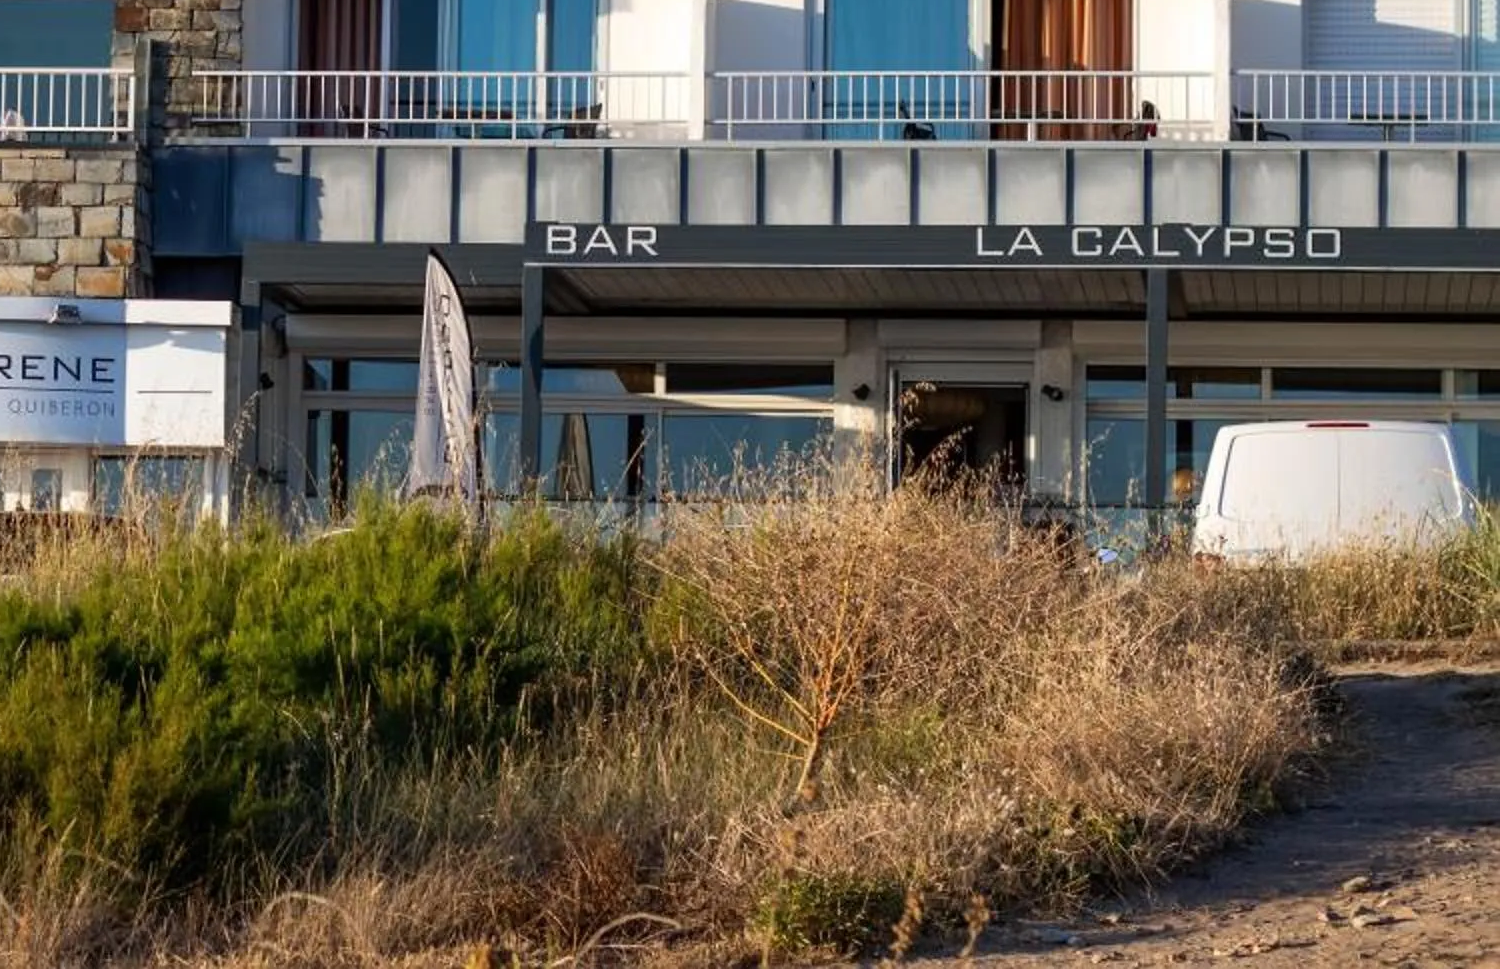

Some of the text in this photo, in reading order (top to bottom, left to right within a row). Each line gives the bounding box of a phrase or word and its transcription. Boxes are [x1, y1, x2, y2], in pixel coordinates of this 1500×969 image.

[546, 224, 659, 256] BAR
[976, 226, 1342, 259] LA CALYPSO
[6, 398, 115, 418] QUIBERON
